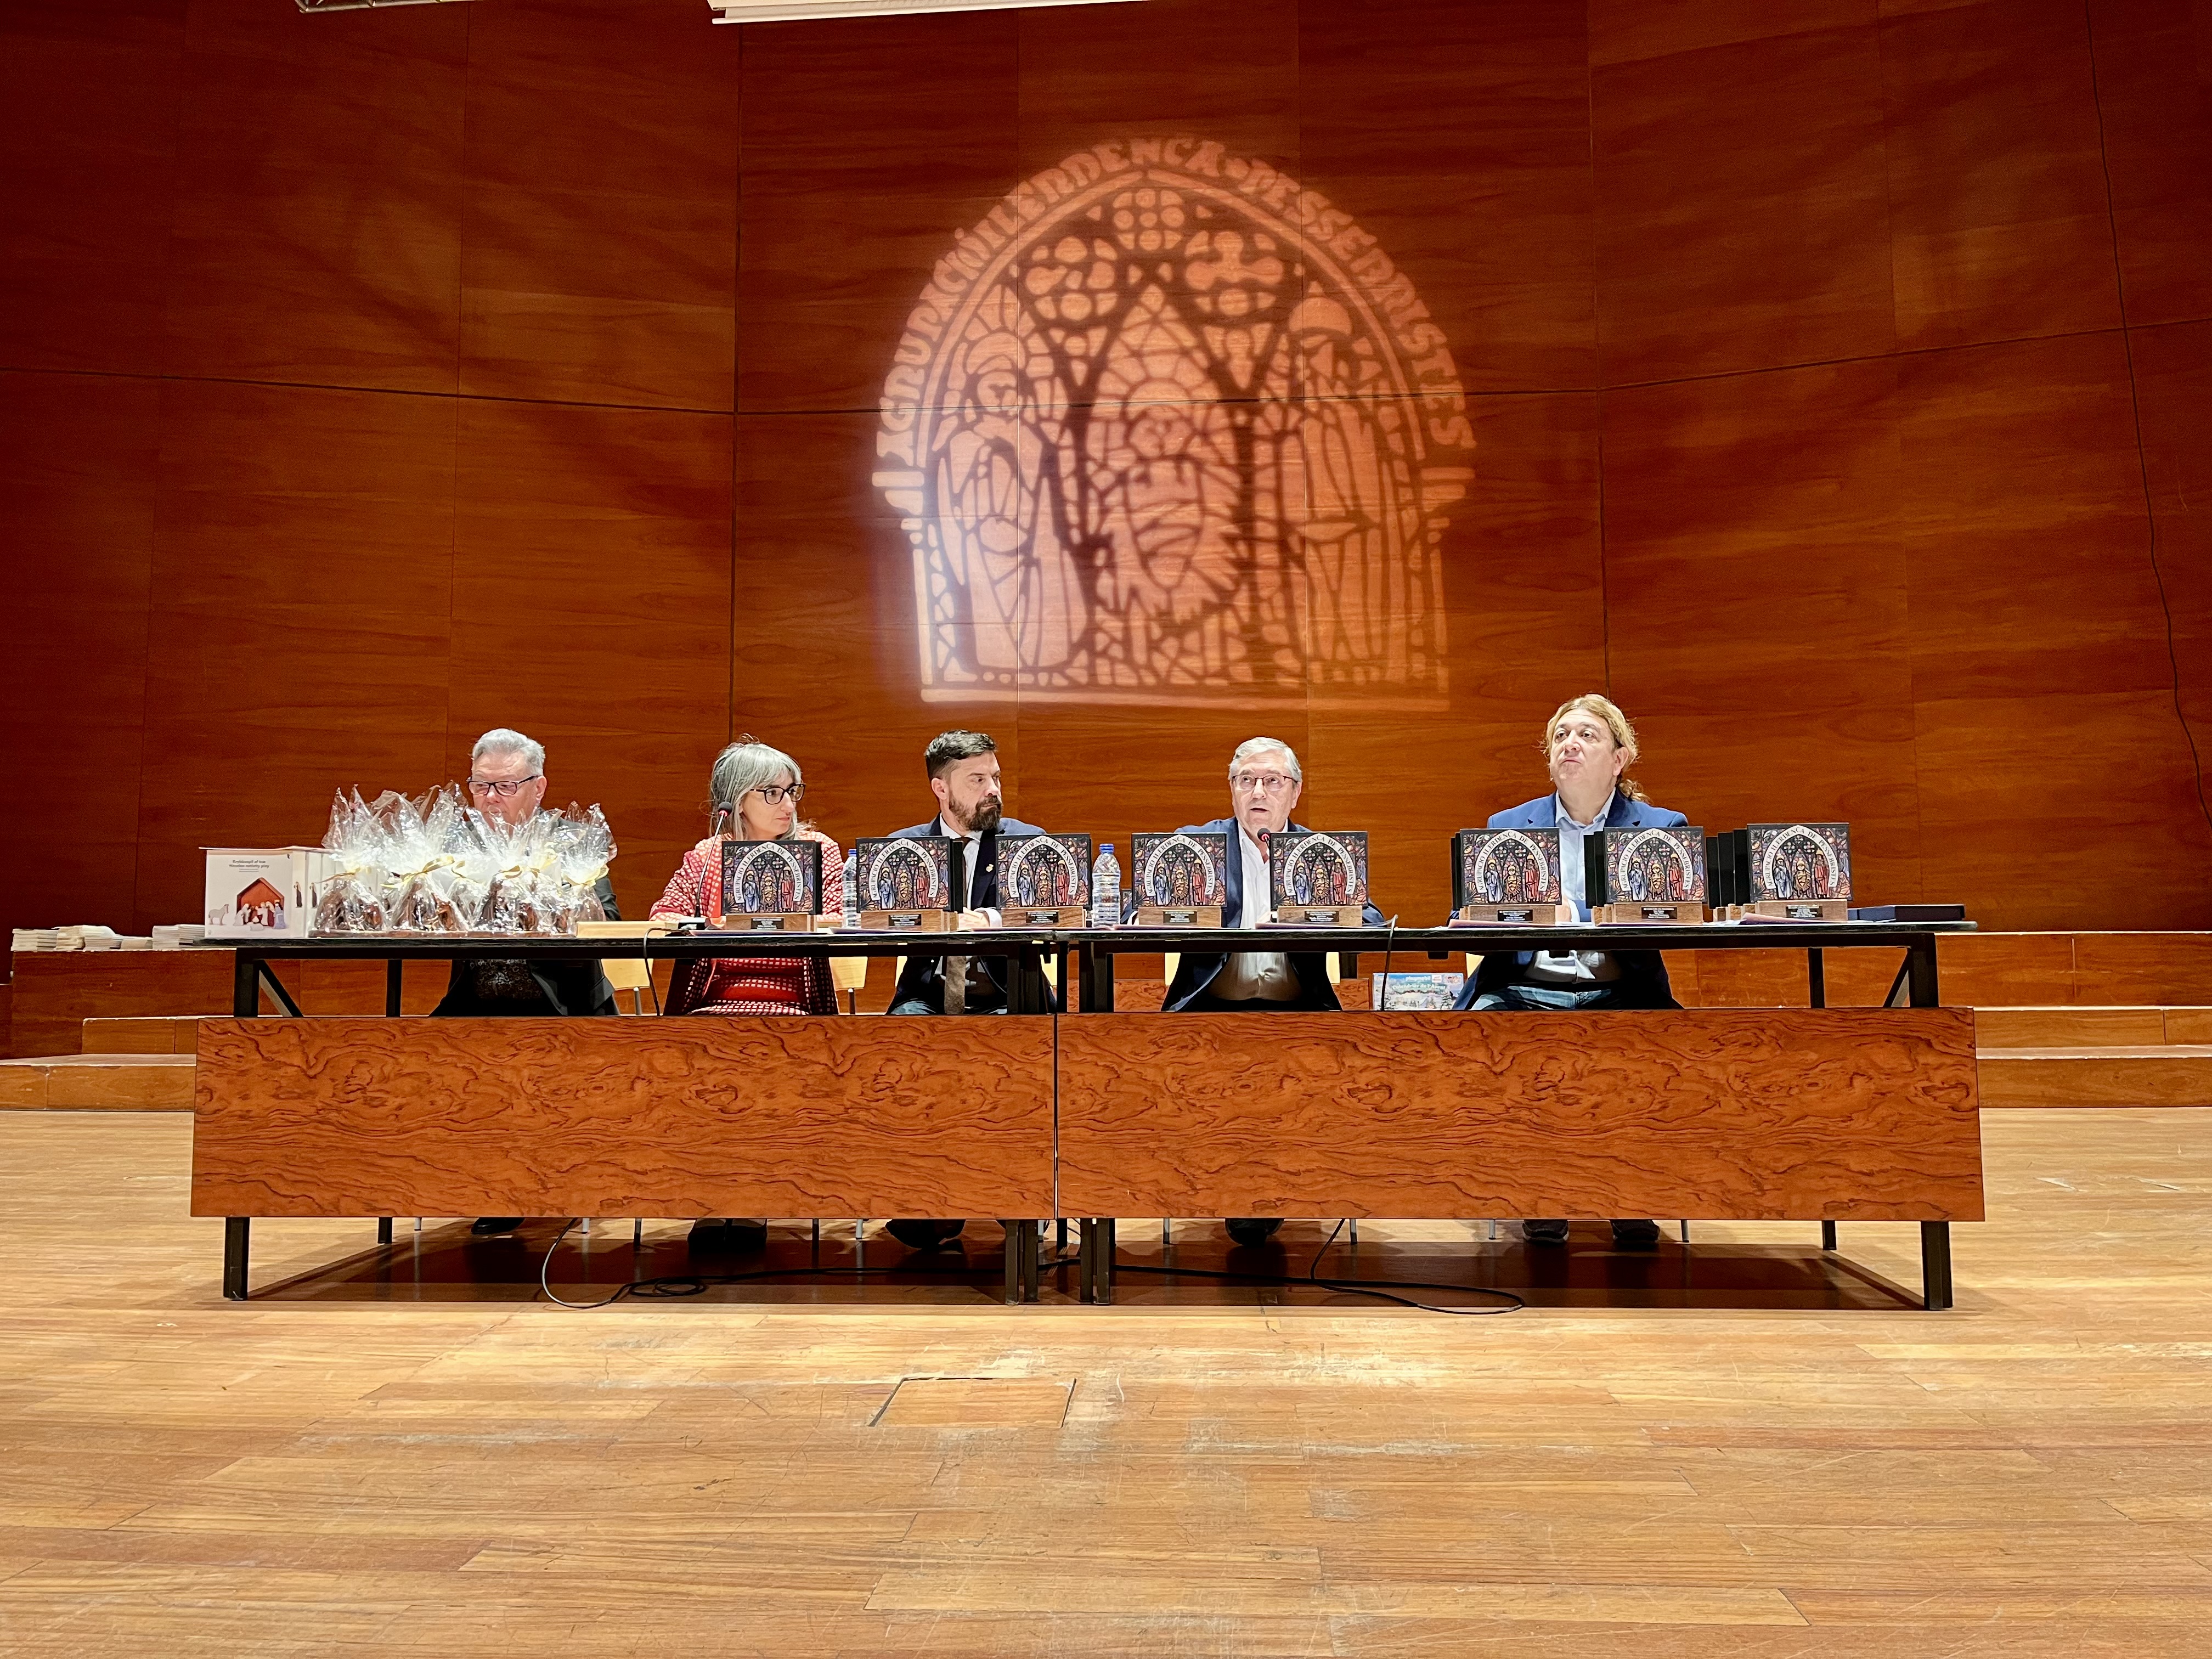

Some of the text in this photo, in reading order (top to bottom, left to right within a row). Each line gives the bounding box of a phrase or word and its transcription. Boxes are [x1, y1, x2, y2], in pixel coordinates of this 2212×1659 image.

[777, 848, 785, 856] DE
[787, 856, 802, 900] PESSEBRISTES
[912, 844, 920, 852] DE
[921, 851, 936, 895] PESSEBRISTES
[1051, 842, 1059, 850] DE
[1061, 849, 1076, 893] PESSEBRISTES
[1188, 840, 1196, 849] DE
[1198, 848, 1213, 893] PESSEBRISTES
[1328, 839, 1336, 848] DE
[1339, 848, 1354, 892] PESSEBRISTES
[1519, 836, 1528, 845] DE
[1530, 844, 1547, 889] PESSEBRISTES
[1663, 834, 1672, 843] DE
[1674, 843, 1691, 888] PESSEBRISTES
[1807, 832, 1817, 840] DE
[1819, 840, 1836, 885] PESSEBRISTES
